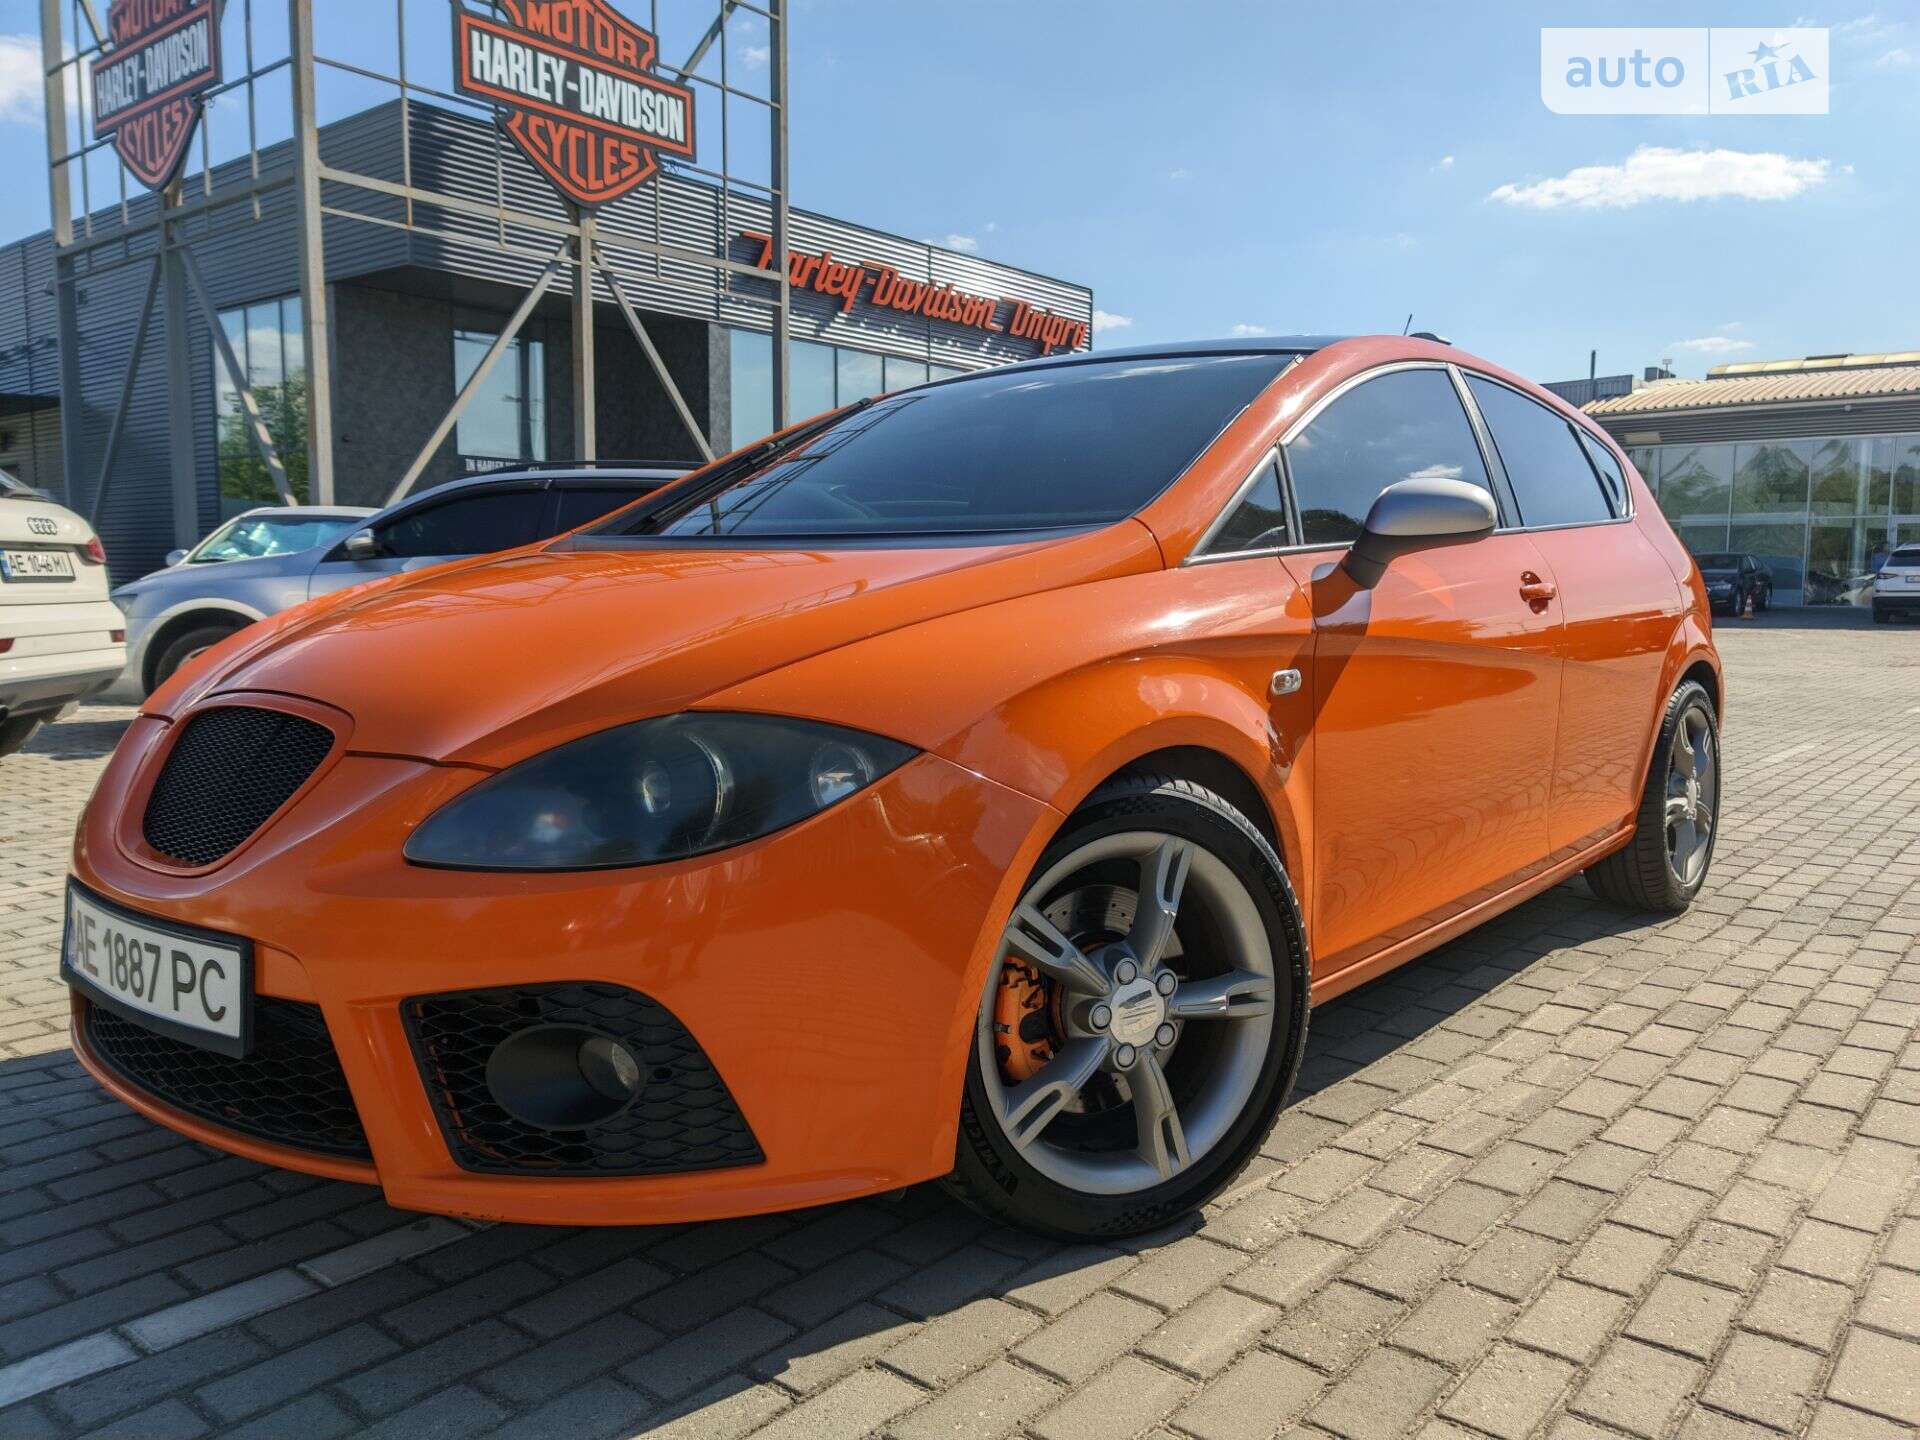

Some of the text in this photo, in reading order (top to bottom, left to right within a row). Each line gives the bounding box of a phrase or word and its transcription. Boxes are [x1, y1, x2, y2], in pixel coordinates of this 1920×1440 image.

[95, 18, 208, 118] HARLEY-DAVIDSON
[527, 0, 638, 68] MOTOR
[471, 30, 685, 143] HARLEY-DAVIDSON
[124, 99, 184, 172] CYCLES
[527, 115, 640, 190] CYCLES
[9, 554, 28, 573] AE
[75, 910, 226, 1022] AE 1887 PC
